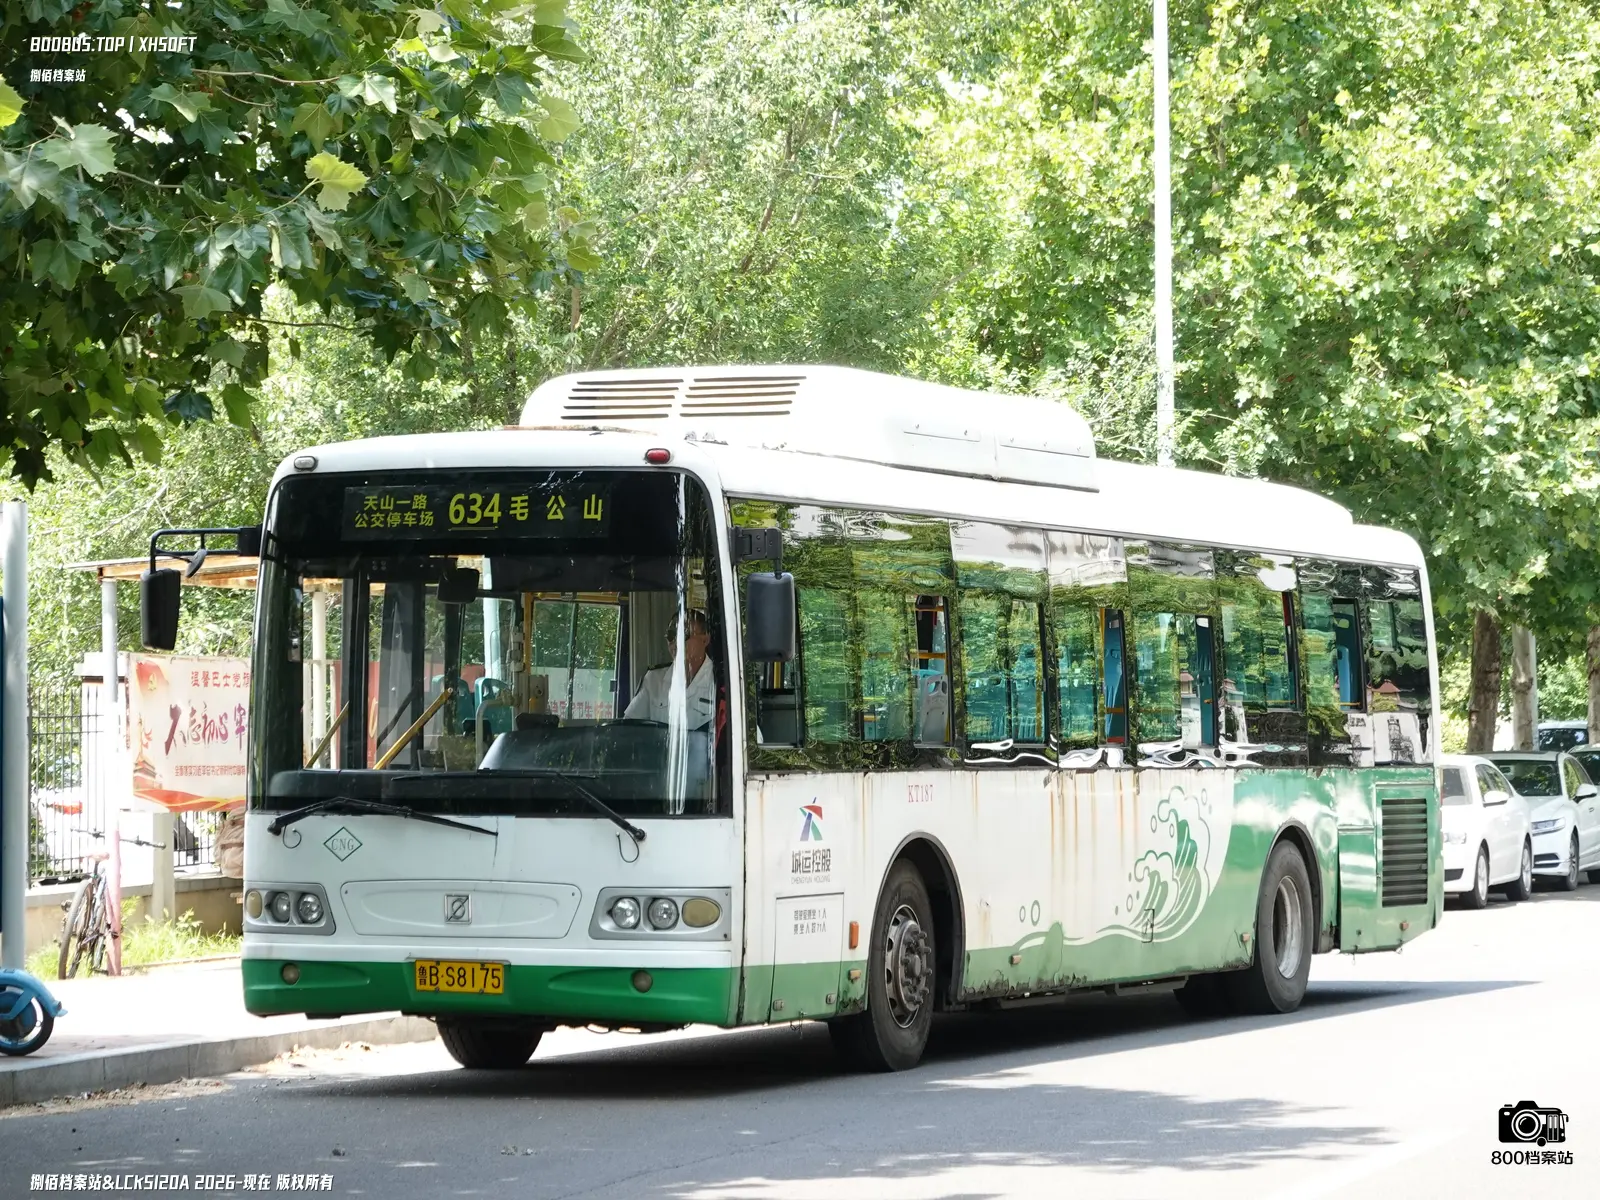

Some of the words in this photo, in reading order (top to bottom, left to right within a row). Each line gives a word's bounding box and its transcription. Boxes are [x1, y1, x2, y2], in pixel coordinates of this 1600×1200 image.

[363, 495, 428, 511] 天山一路
[449, 492, 501, 525] 634
[509, 494, 603, 521] 毛公山
[354, 511, 434, 528] 公交停车场
[908, 785, 934, 803] KT187
[331, 838, 355, 850] CNG
[791, 848, 831, 874] 城运控股
